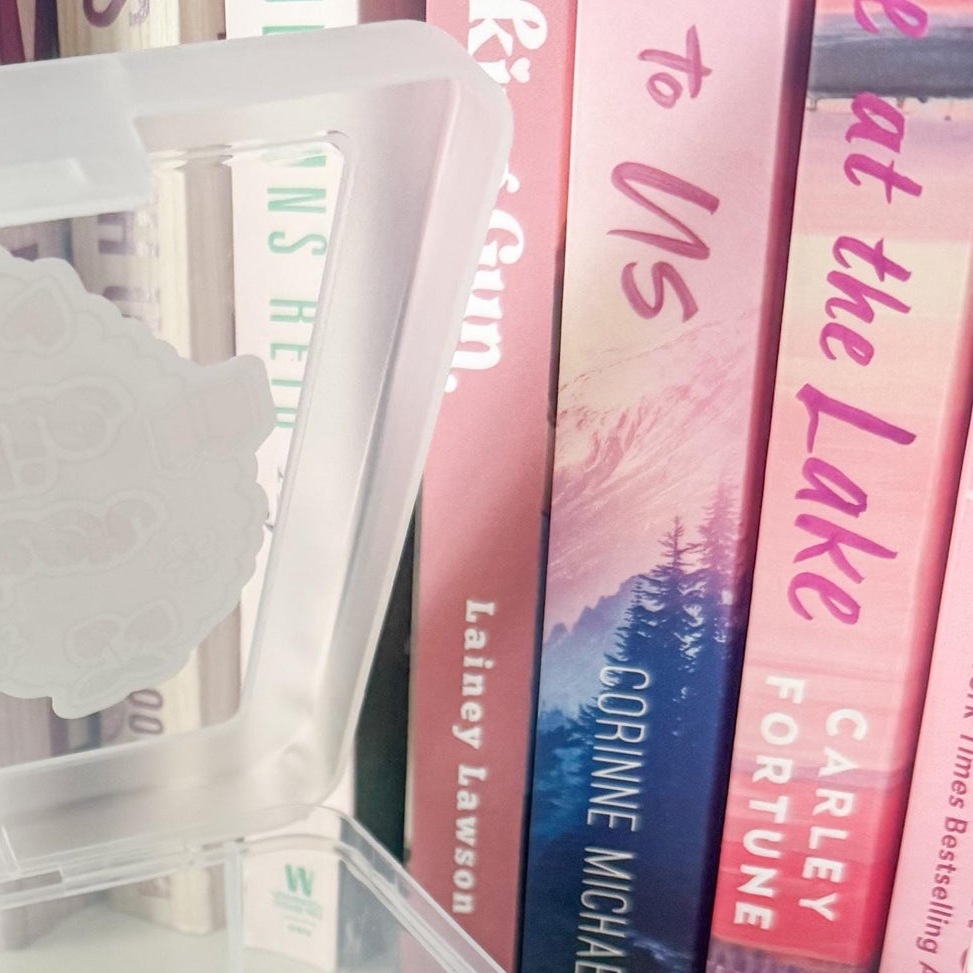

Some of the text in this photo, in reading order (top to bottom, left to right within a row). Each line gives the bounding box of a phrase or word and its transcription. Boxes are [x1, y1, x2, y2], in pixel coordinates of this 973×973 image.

[638, 25, 712, 108] to
[843, 91, 923, 204] at
[819, 235, 912, 367] the
[787, 383, 917, 626] Lake
[451, 600, 495, 915] Lainey Lawson
[586, 664, 651, 833] CORINNE
[733, 675, 806, 931] FORTUNE
[798, 707, 869, 923] CARLEY
[915, 814, 968, 969] Bestselling
